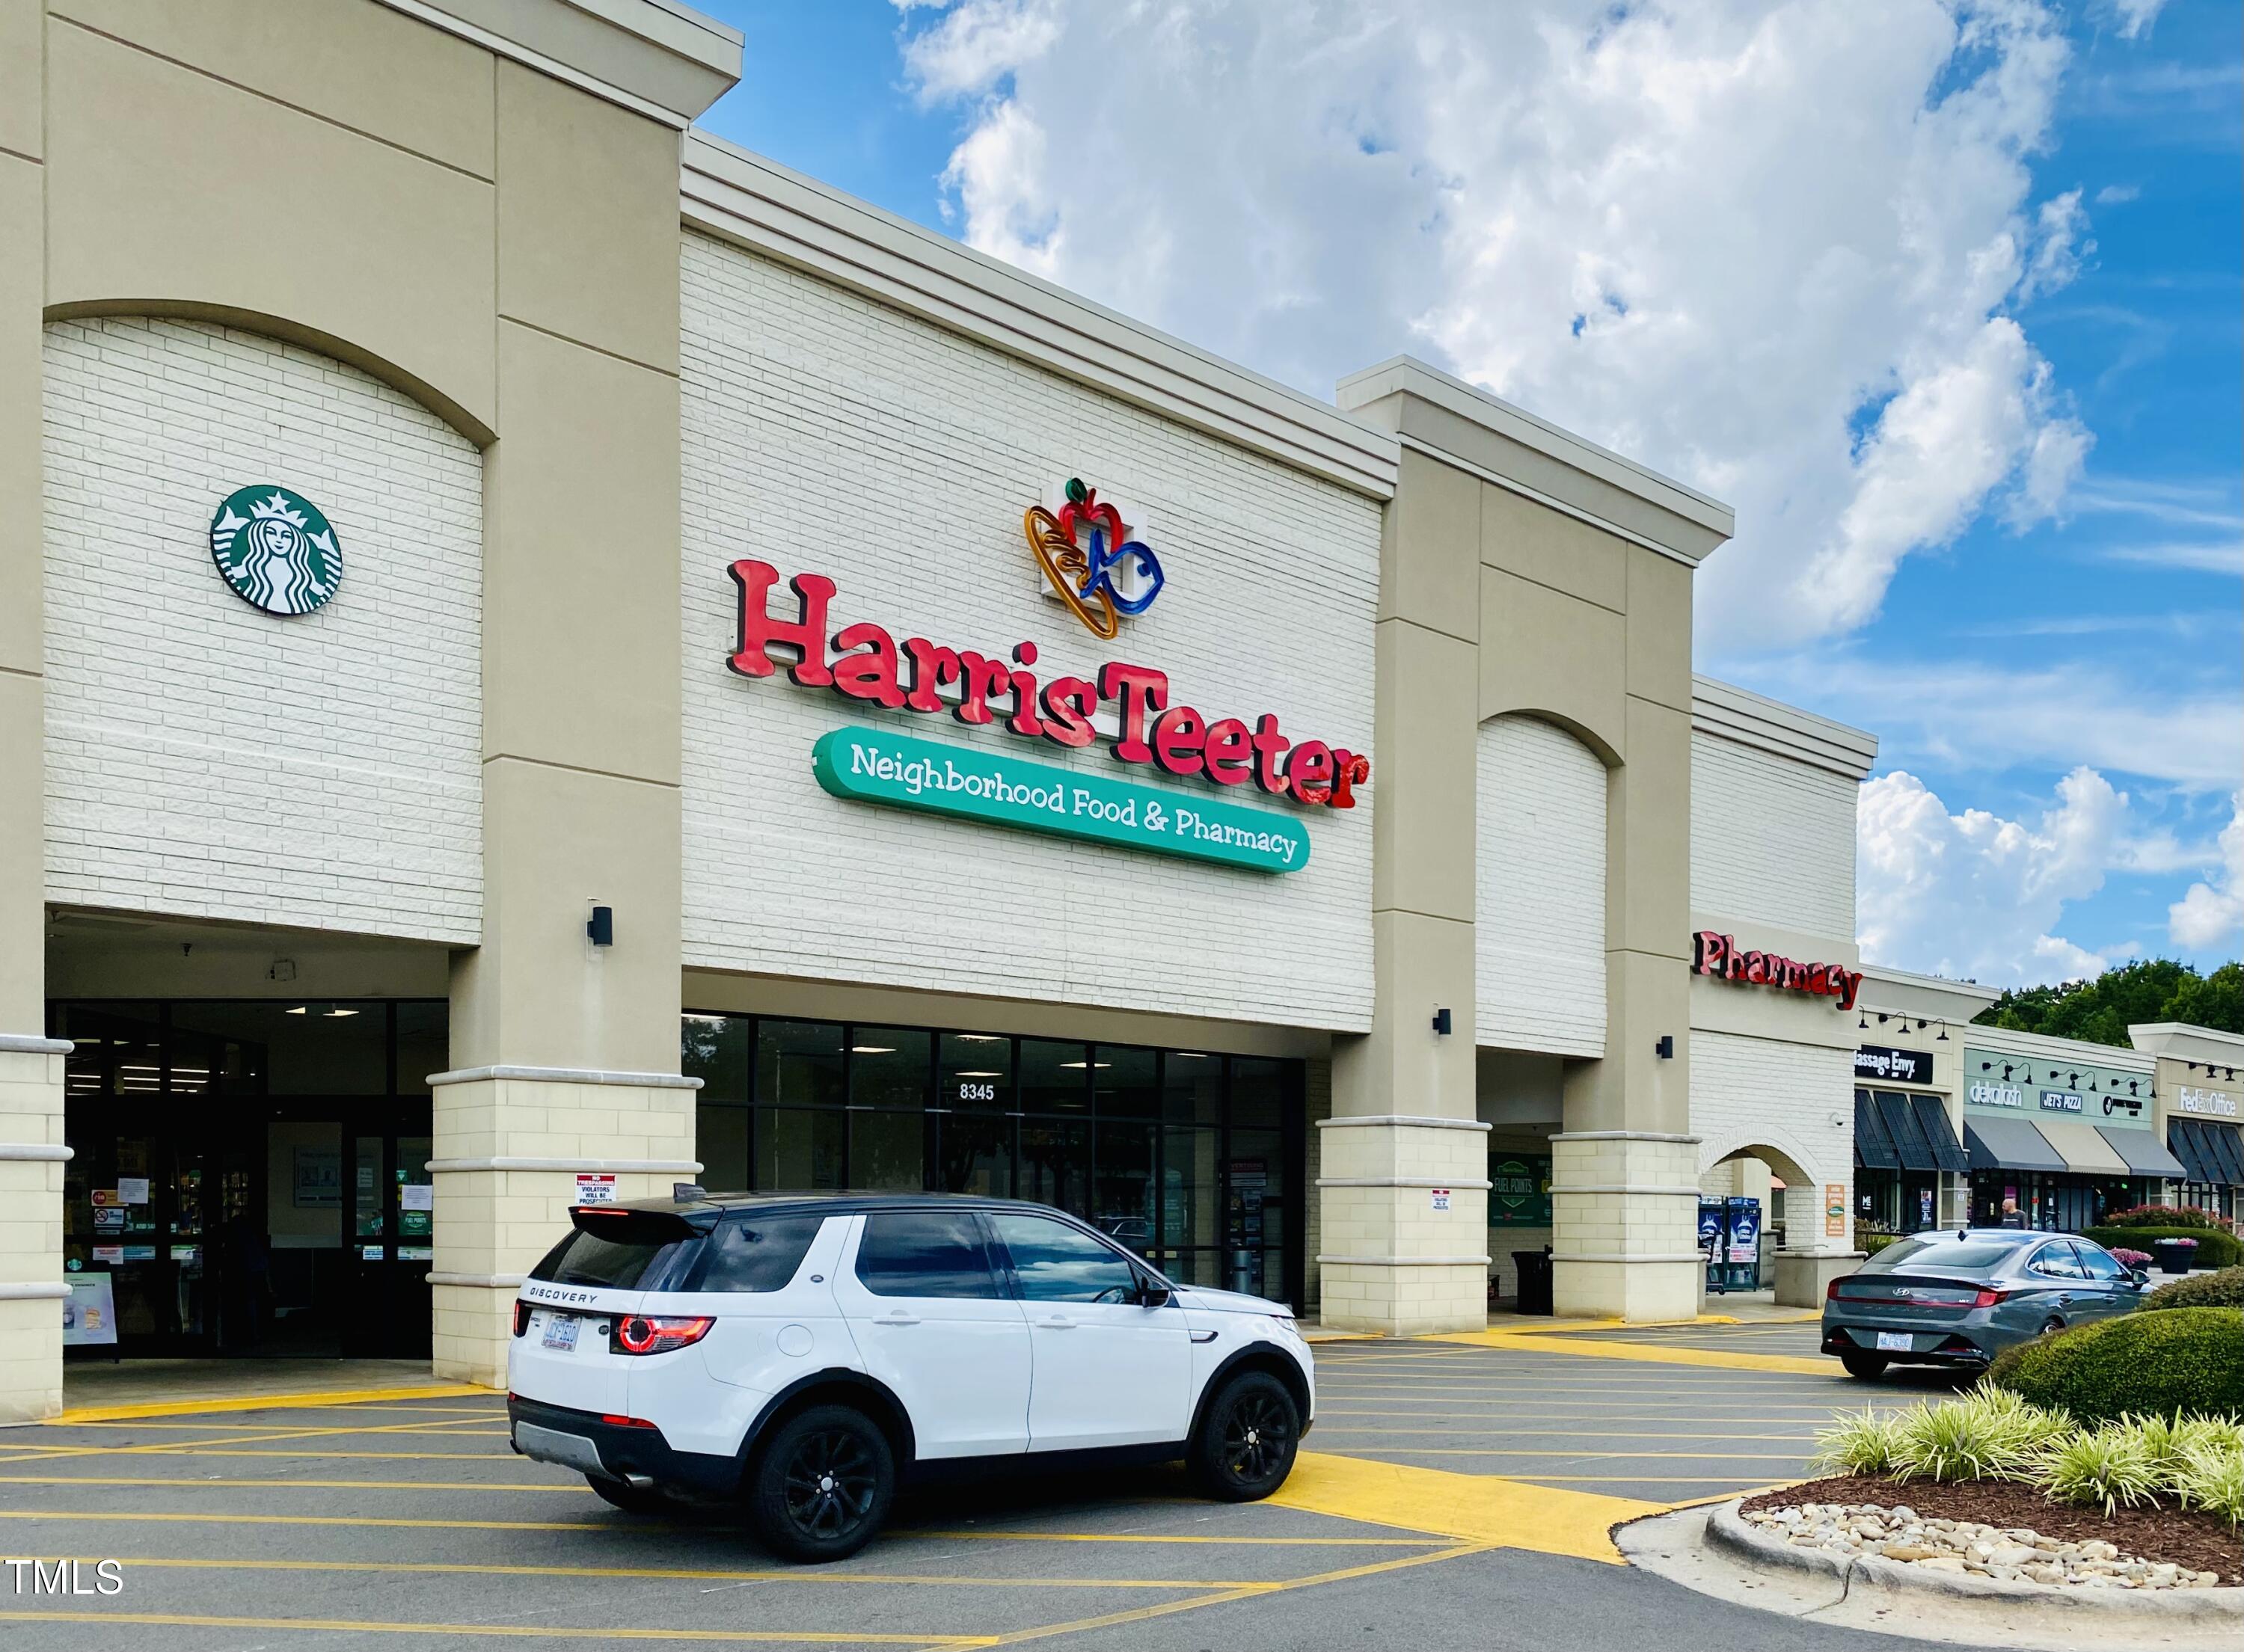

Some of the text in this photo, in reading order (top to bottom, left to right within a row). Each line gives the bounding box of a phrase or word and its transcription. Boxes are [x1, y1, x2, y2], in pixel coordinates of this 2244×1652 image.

[850, 743, 1298, 863] Neighborhood Food & Pharmacy
[1693, 930, 1863, 1010] Pharmacy
[960, 1083, 994, 1101] 8345
[1969, 1080, 2023, 1107] dekalash
[2043, 1093, 2082, 1110] JET'S PIZZA
[2210, 1092, 2237, 1117] Office
[1495, 1177, 1533, 1194] FUEL POINTS
[530, 1287, 598, 1304] DISCOVERY
